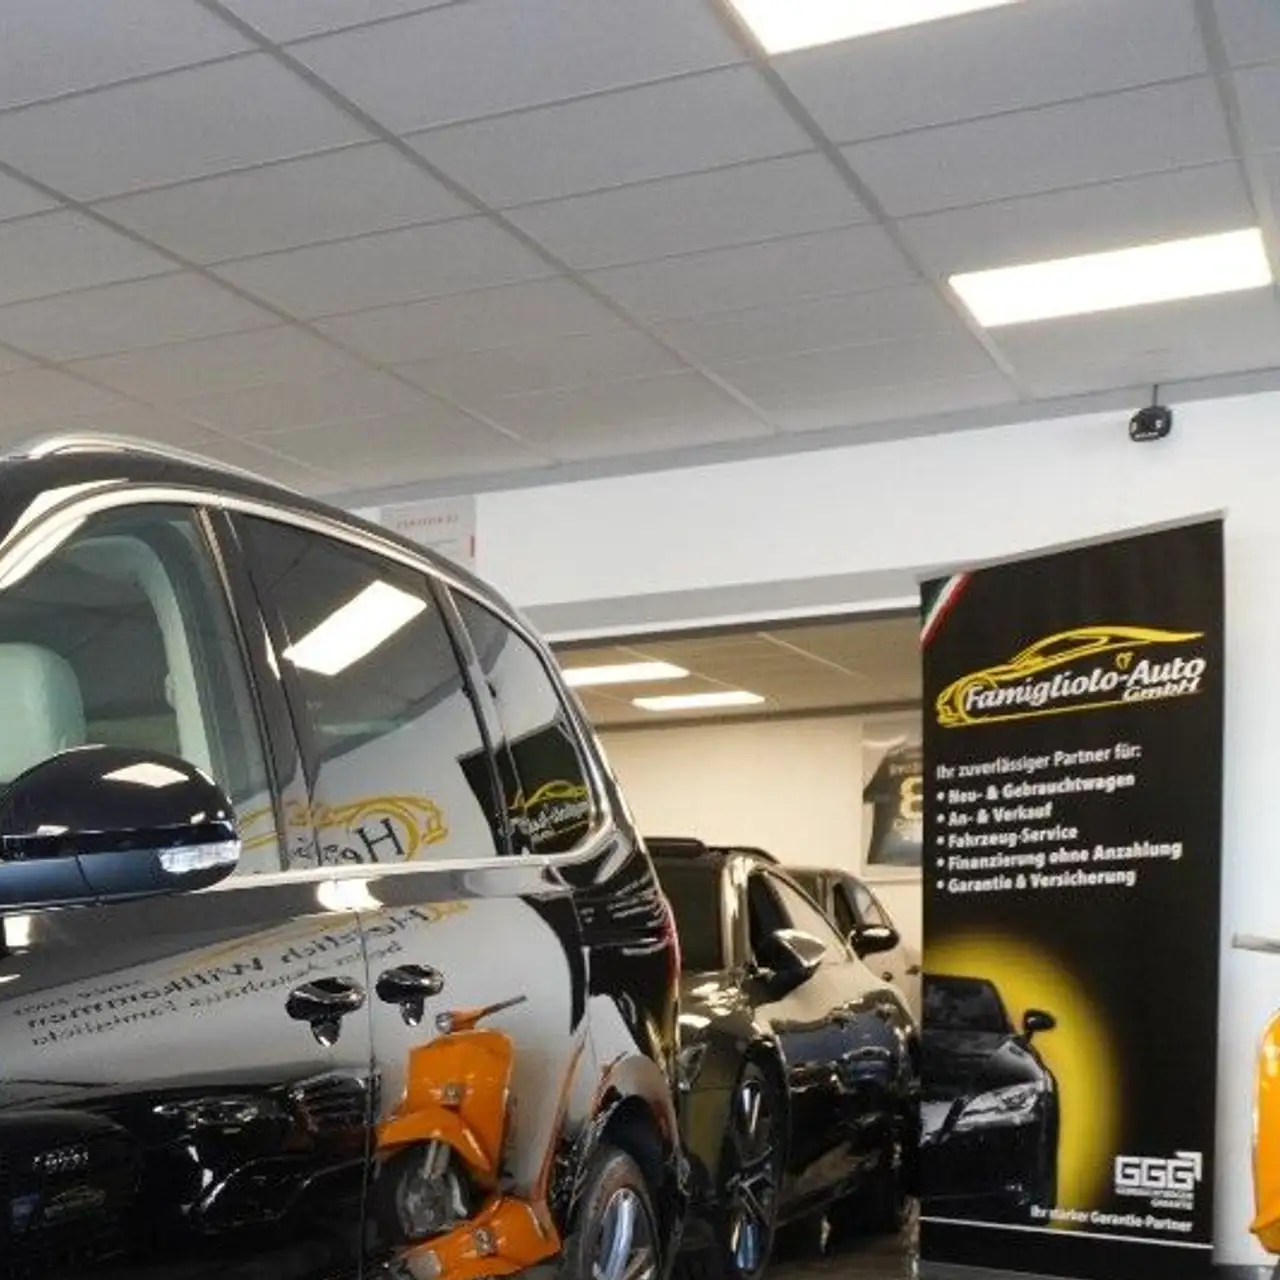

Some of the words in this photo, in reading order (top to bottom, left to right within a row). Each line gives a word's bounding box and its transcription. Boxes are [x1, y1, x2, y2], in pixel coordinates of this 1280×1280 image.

[1122, 677, 1202, 702] GmbH
[936, 764, 956, 781] Ihr
[957, 754, 1051, 779] zuverlässiger
[1053, 747, 1112, 768] Partner
[1114, 741, 1143, 760] für:
[948, 788, 983, 805] Neu-
[986, 785, 999, 801] &
[1001, 772, 1136, 799] Gebrauchtwagen
[948, 811, 974, 827] An-
[976, 808, 990, 825] &
[992, 801, 1053, 823] Verkauf
[948, 824, 1079, 849] Fahrzeug-Service
[948, 850, 1046, 871] Finanzierung
[1048, 845, 1089, 865] ohne
[1092, 840, 1184, 861] Anzahlung
[948, 874, 1013, 893] Garantie
[1015, 874, 1028, 890] &
[1030, 868, 1137, 888] Versicherung
[1091, 1210, 1194, 1233] Garantie-Partner
